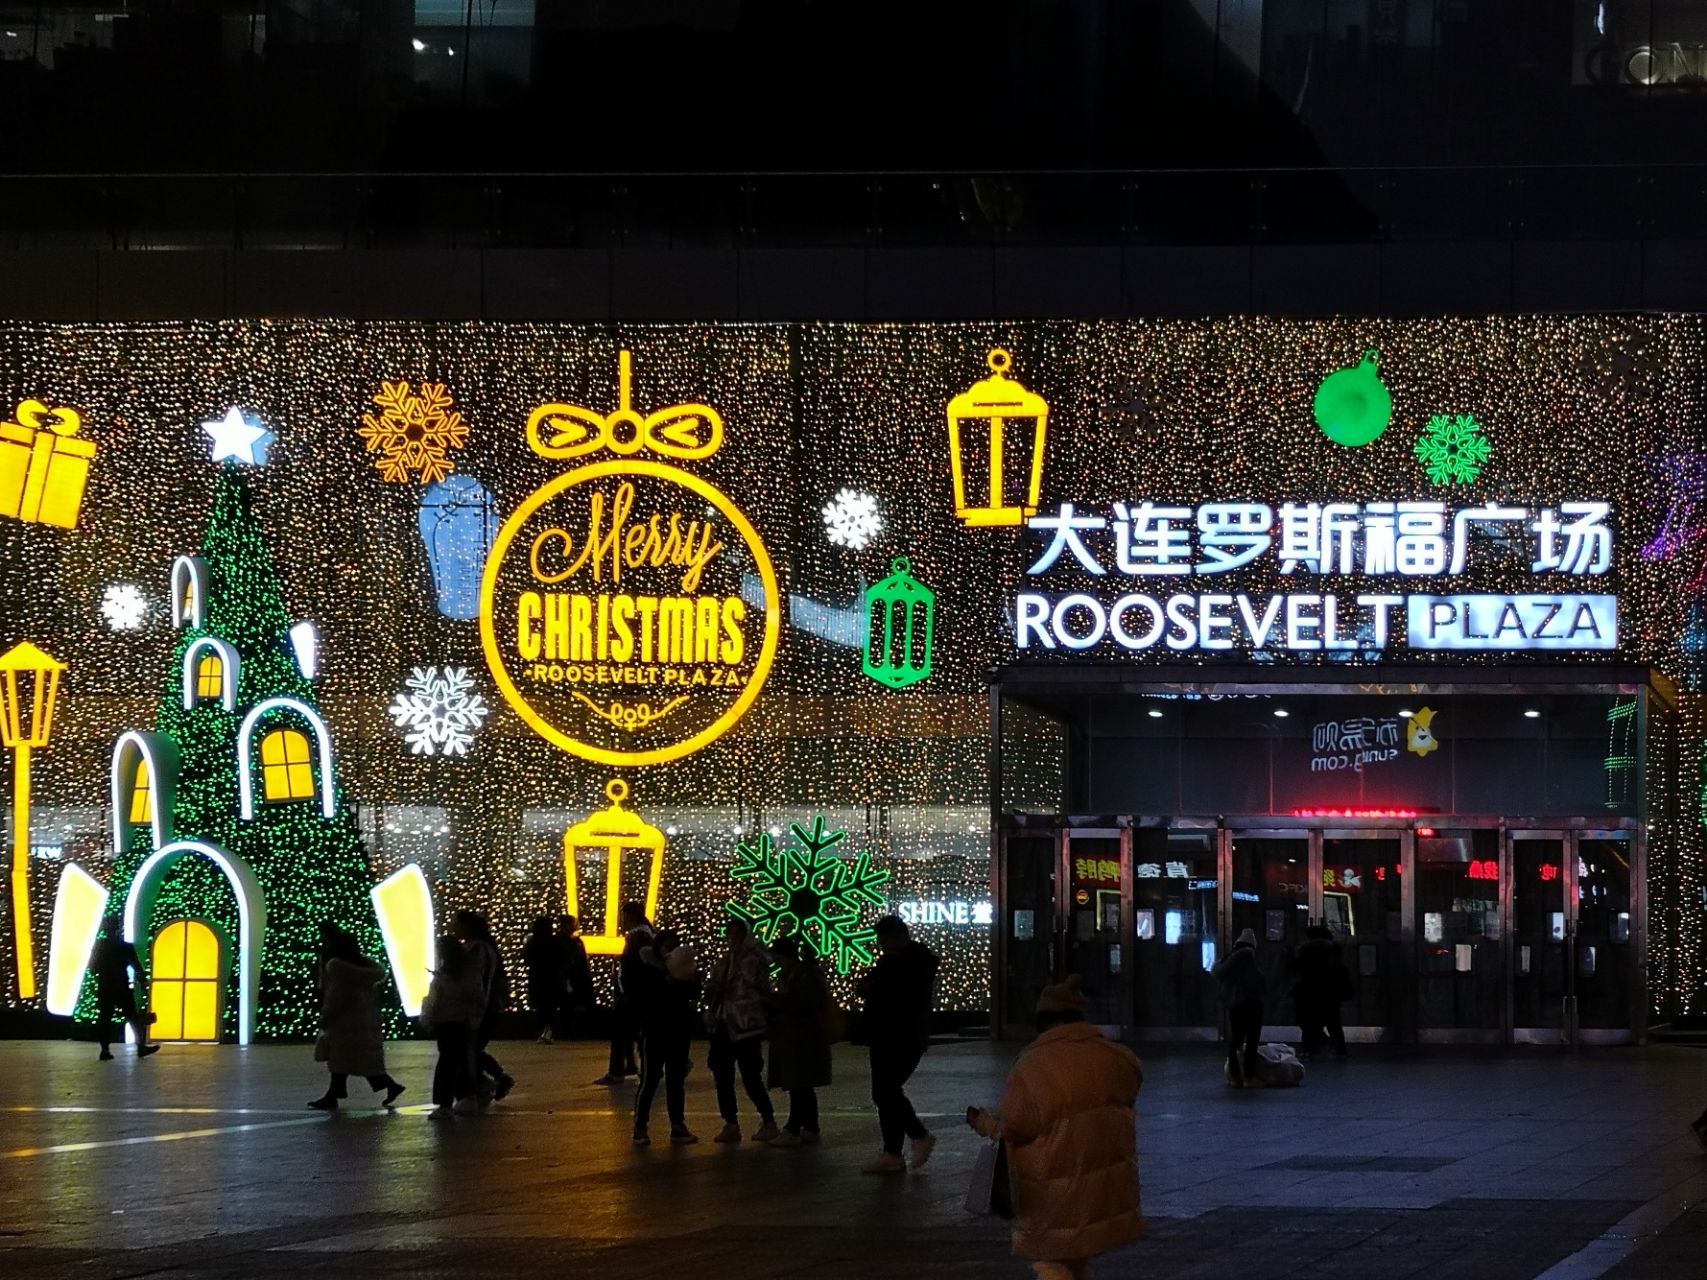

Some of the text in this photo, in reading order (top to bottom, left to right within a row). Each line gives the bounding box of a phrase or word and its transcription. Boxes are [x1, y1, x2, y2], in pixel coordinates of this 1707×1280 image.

[530, 482, 723, 592] Merry
[1026, 502, 1612, 575] 大连罗斯福广场
[518, 591, 745, 665] CHRISTMAS
[1017, 594, 1603, 650] ROOSEVELT PLAZA
[898, 902, 968, 923] SHINE
